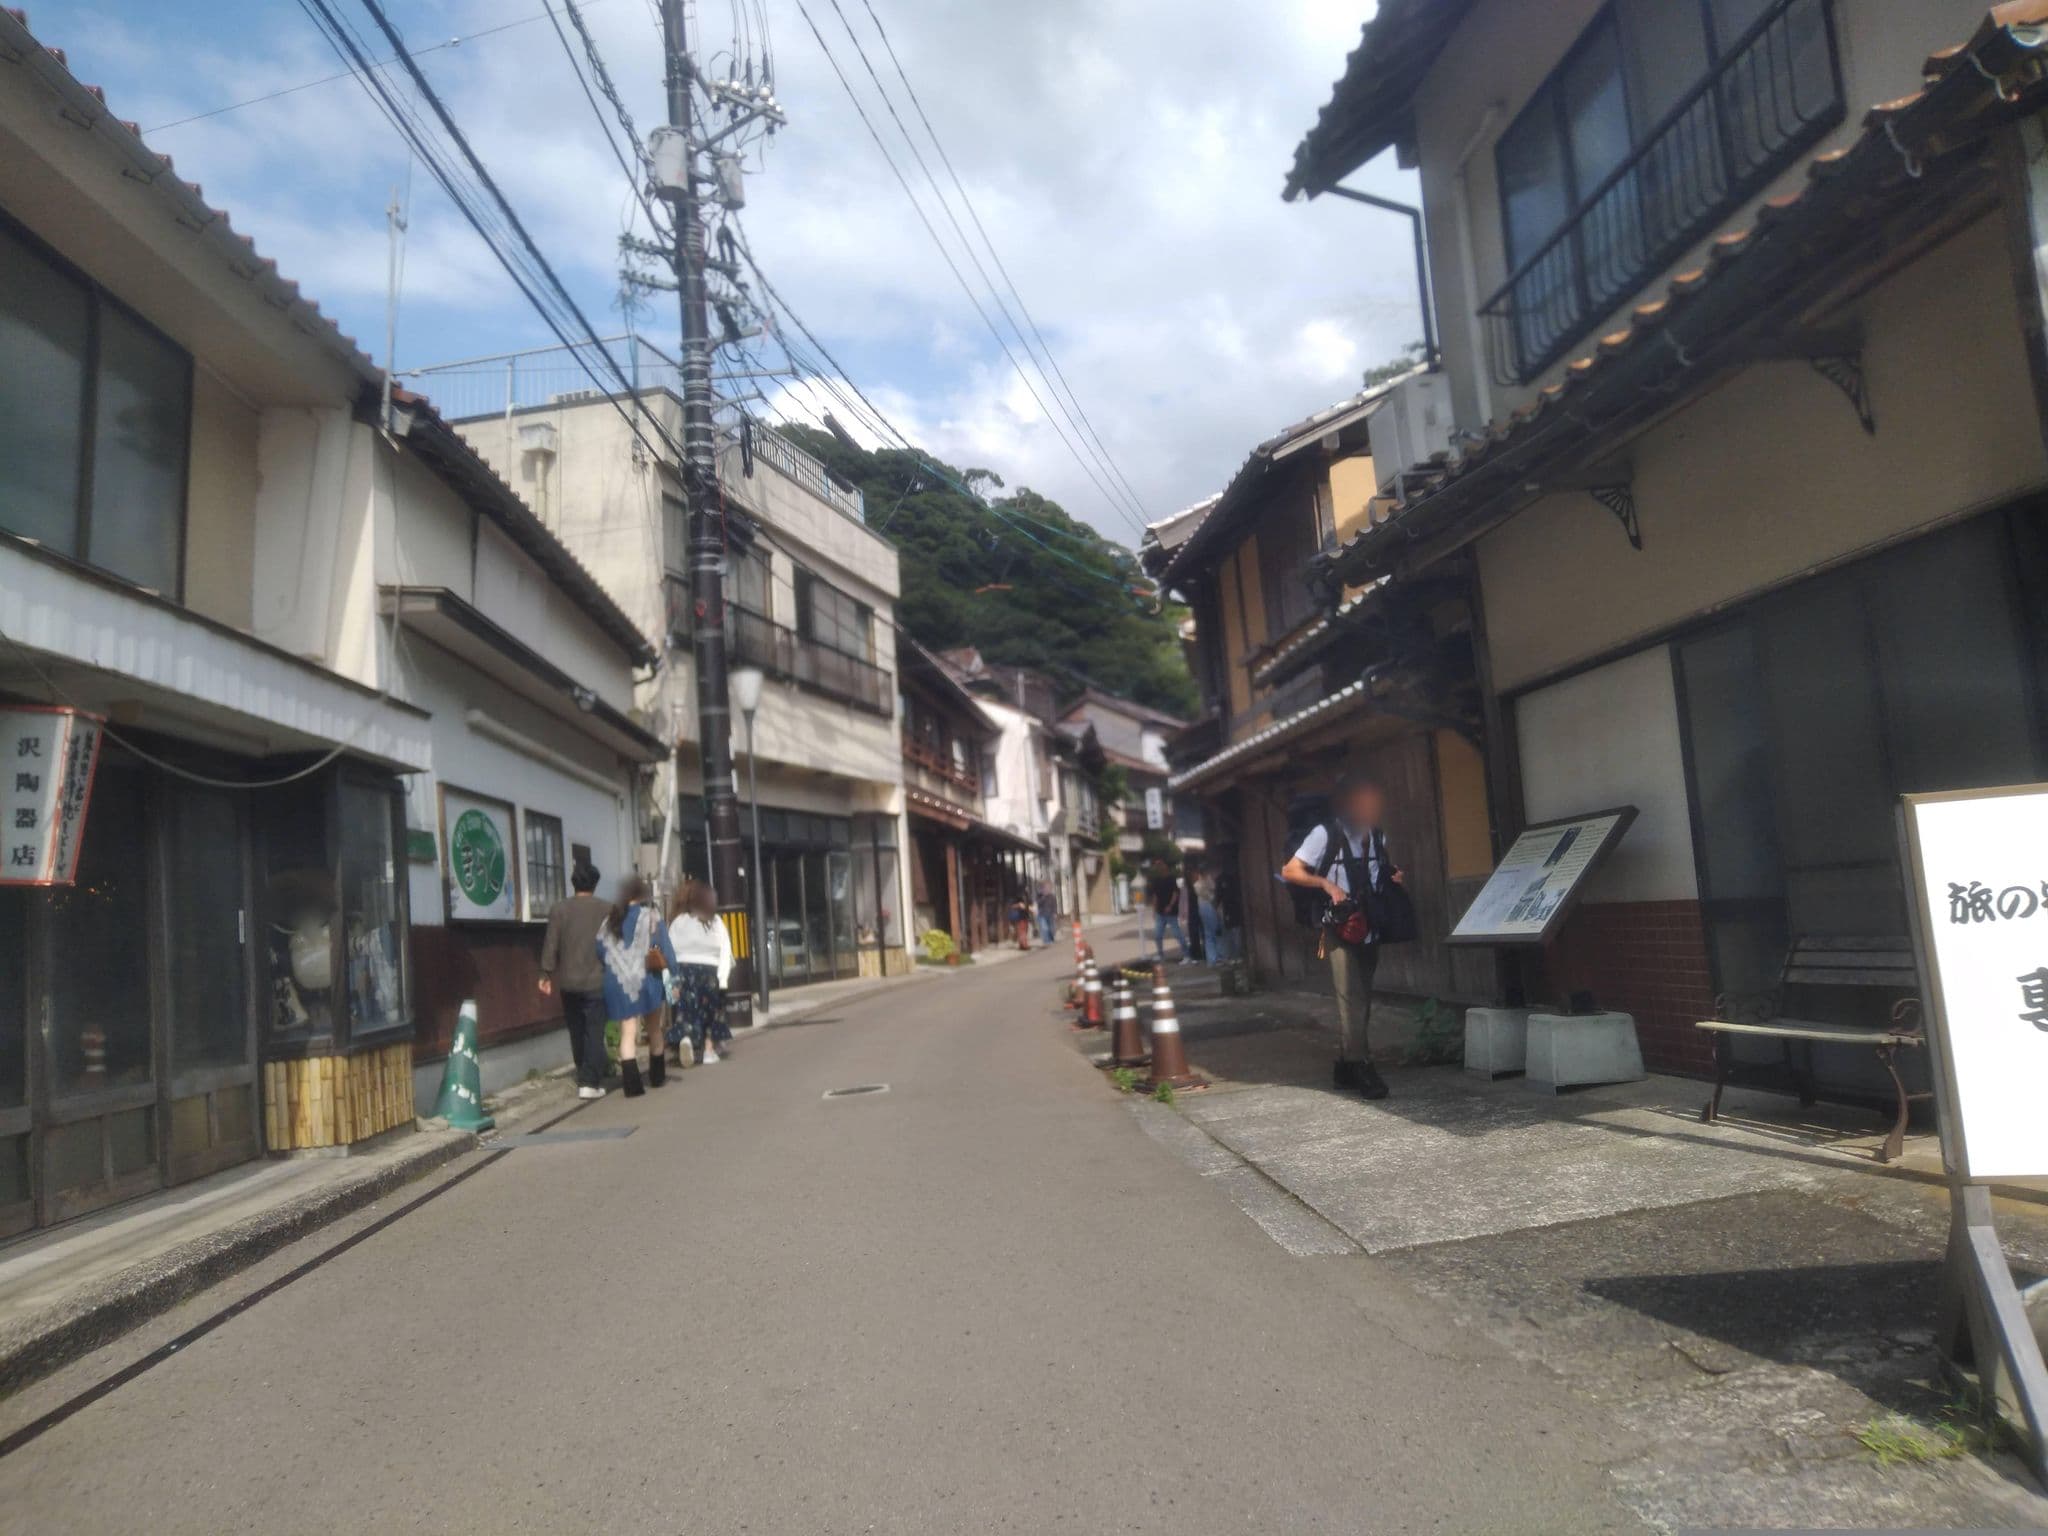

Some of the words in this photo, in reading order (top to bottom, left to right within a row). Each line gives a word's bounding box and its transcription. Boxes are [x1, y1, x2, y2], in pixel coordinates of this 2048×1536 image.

[12, 736, 41, 867] 沢陶器店
[1947, 880, 2048, 925] 旅の
